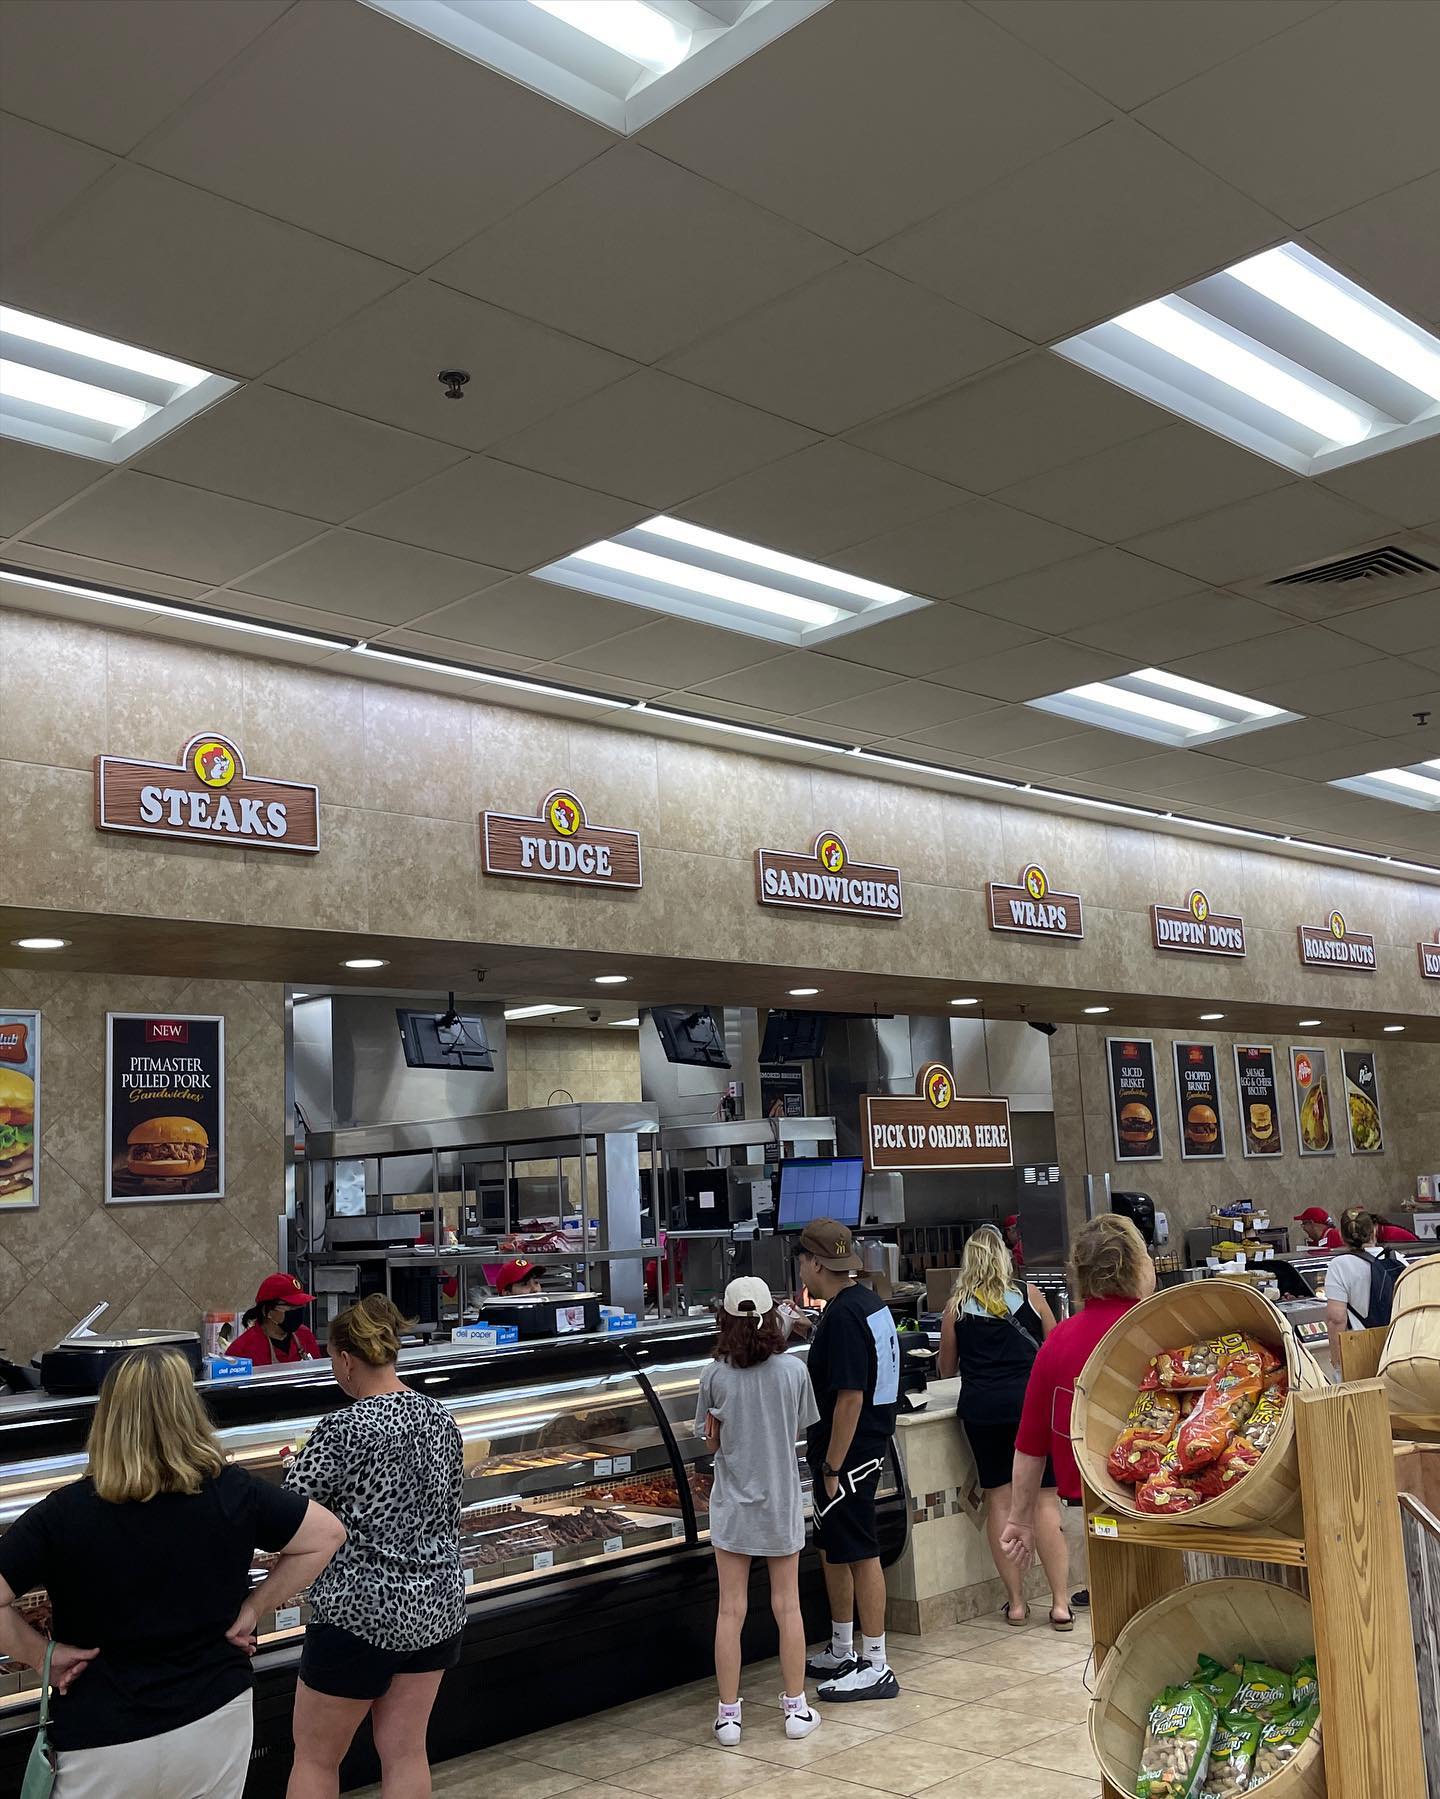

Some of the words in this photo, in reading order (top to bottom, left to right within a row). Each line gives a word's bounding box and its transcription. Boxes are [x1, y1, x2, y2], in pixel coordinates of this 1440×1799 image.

[139, 785, 288, 838] STEAKS
[519, 835, 613, 877] FUDGE
[764, 867, 900, 910] SANDWICHES
[1009, 899, 1067, 930] WRAPS
[1158, 918, 1207, 945] DIPPIN'
[1208, 925, 1243, 950] DOTS
[1304, 938, 1349, 961] ROASTED
[1348, 943, 1375, 965] NUTS
[1424, 953, 1440, 973] KO
[152, 1024, 183, 1037] NEW
[1247, 1048, 1259, 1056] NEW
[129, 1056, 204, 1072] PITMASTER
[1120, 1066, 1144, 1078] SLICED
[121, 1073, 170, 1088] PULLED
[173, 1074, 212, 1089] PORK
[1120, 1078, 1146, 1089] BRISKET
[1184, 1070, 1212, 1081] CHOPPED
[1187, 1081, 1211, 1092] BRISKET
[129, 1088, 204, 1103] Sandwiches
[873, 1124, 907, 1149] PICK
[907, 1125, 926, 1149] UP
[928, 1124, 973, 1149] ORDER
[975, 1124, 1008, 1148] HERE
[456, 1329, 468, 1338] deli
[470, 1331, 492, 1340] paper
[218, 1367, 229, 1375] deli
[229, 1366, 248, 1374] paper
[1234, 1682, 1285, 1705] Hampton
